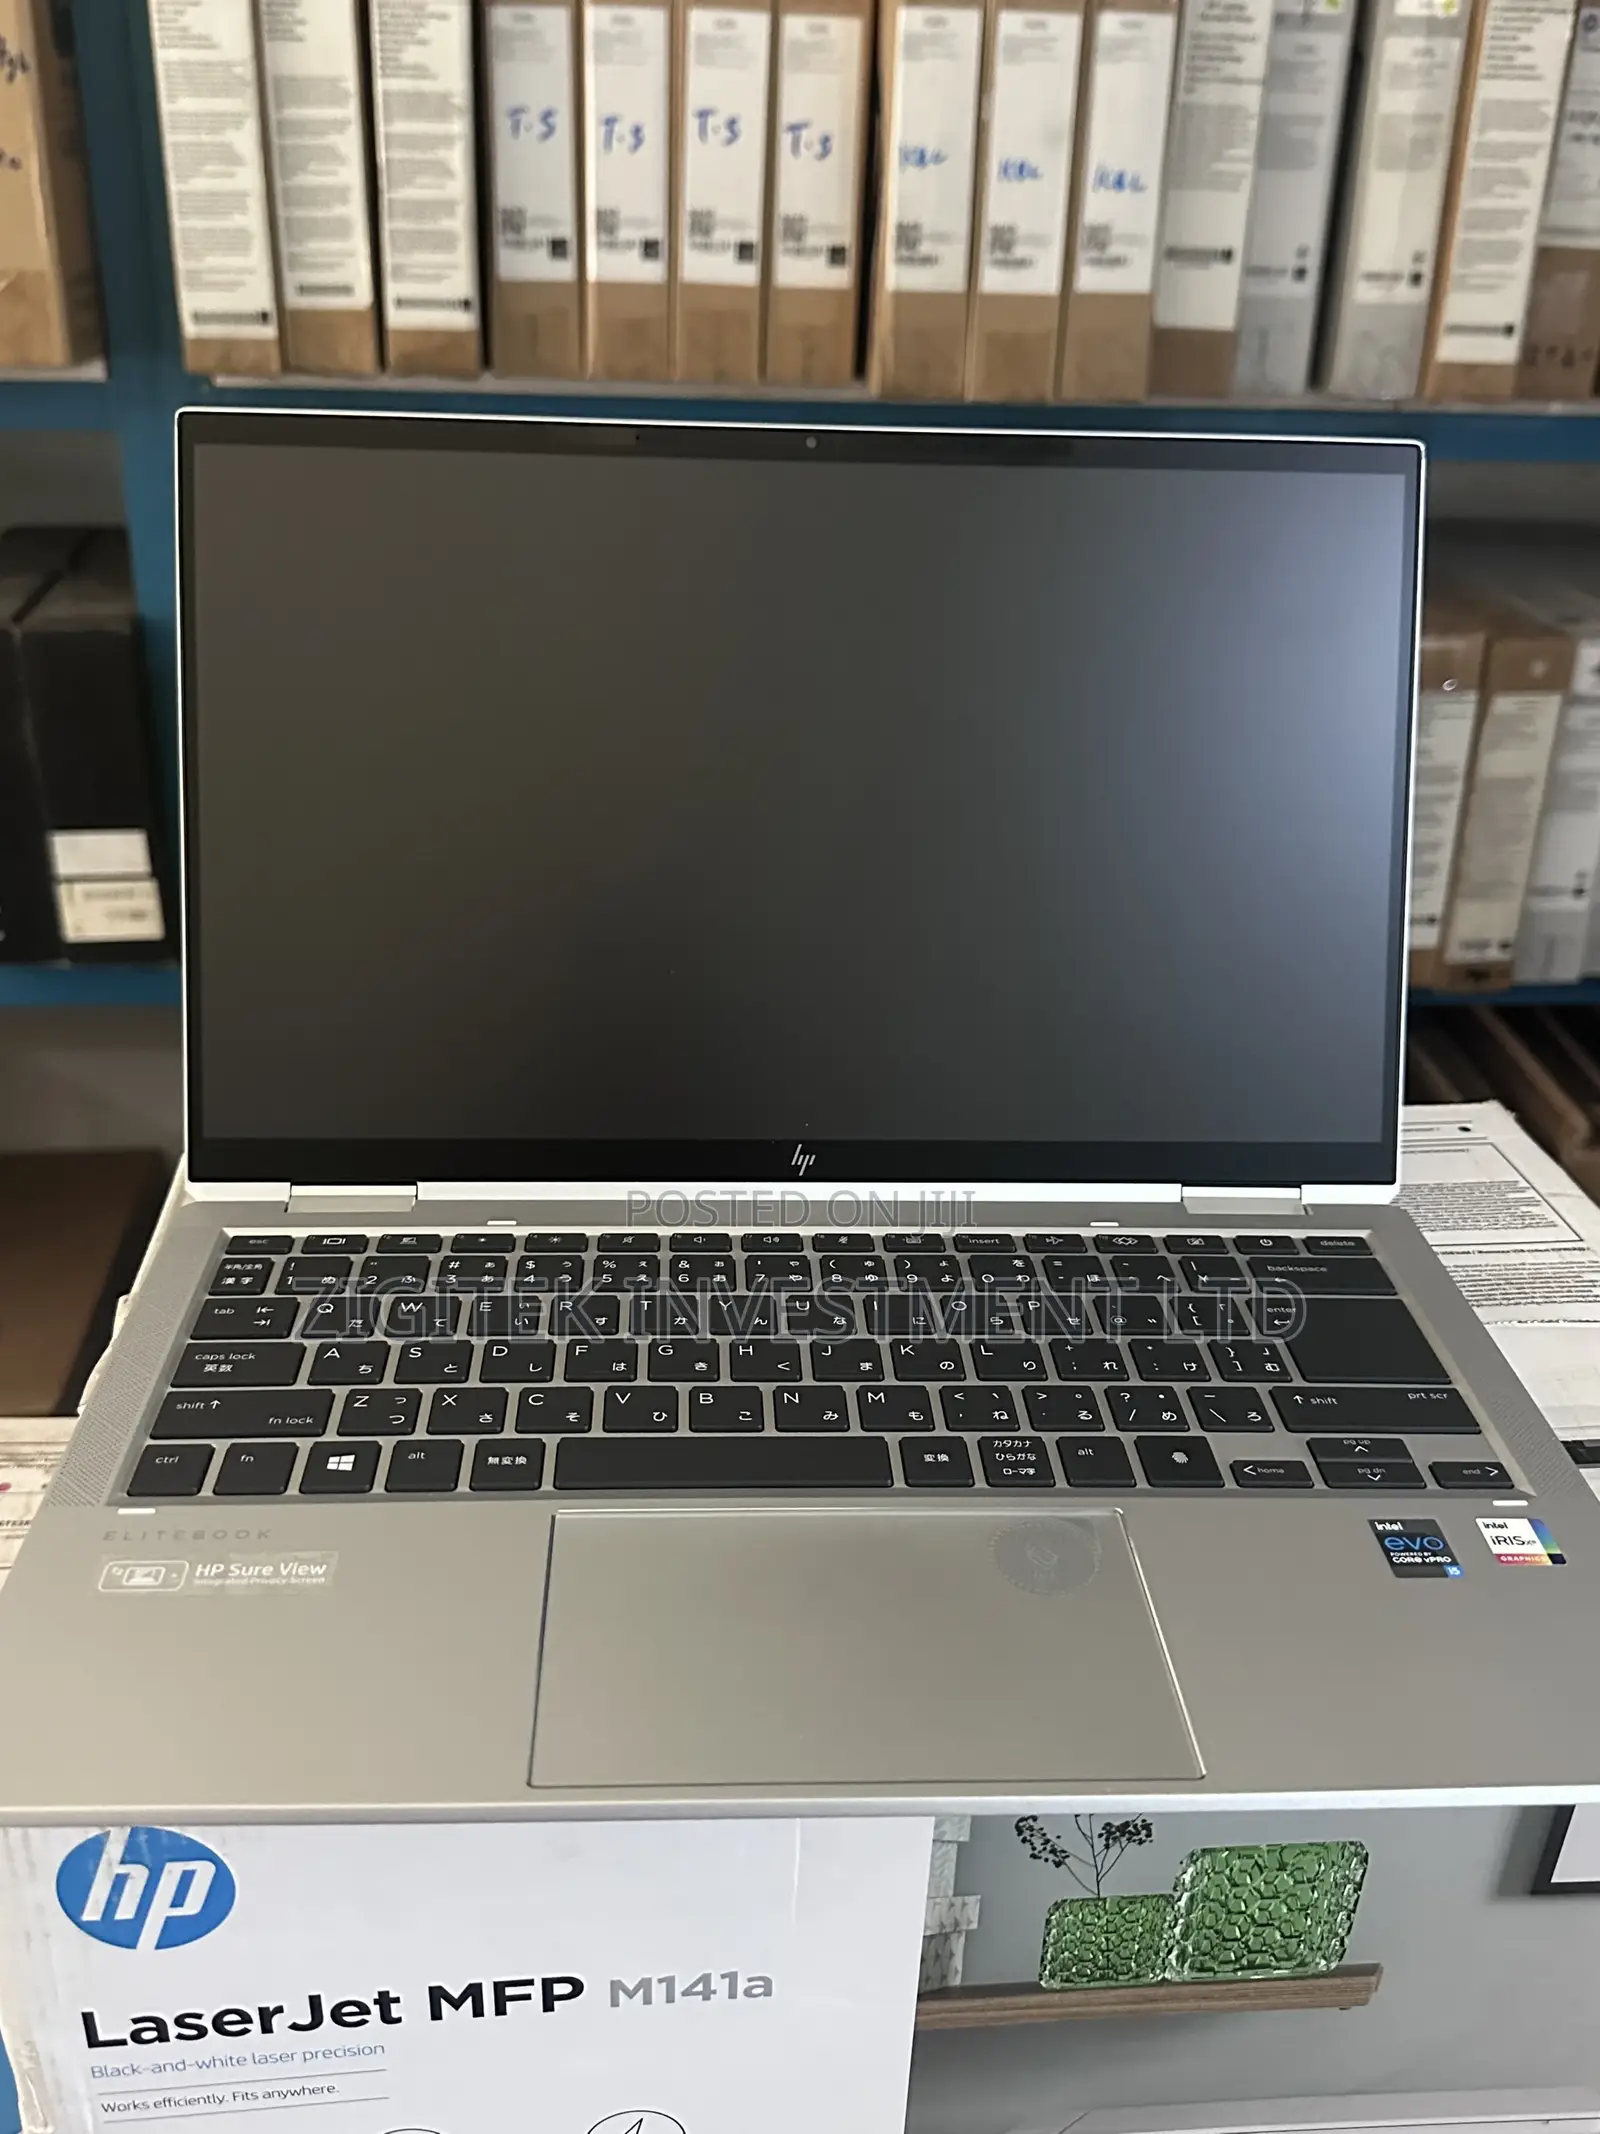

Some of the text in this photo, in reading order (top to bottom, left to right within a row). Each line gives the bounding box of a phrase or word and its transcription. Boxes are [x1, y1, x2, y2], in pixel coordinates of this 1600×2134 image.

[968, 1237, 1000, 1245] insert
[1266, 1264, 1328, 1273] backspace
[365, 1276, 377, 1285] 2
[446, 1274, 457, 1284] 3
[524, 1274, 536, 1283] 4
[602, 1274, 613, 1283] 5
[678, 1274, 690, 1283] 6
[755, 1274, 766, 1282] 7
[831, 1274, 843, 1283] 8
[906, 1274, 918, 1283] 9
[317, 1303, 335, 1313] Q
[401, 1302, 423, 1312] W
[479, 1302, 493, 1311] E
[560, 1302, 573, 1311] R
[640, 1301, 652, 1310] T
[719, 1300, 733, 1310] Y
[796, 1301, 810, 1310] U
[1028, 1301, 1041, 1310] P
[214, 1307, 235, 1315] tab
[1266, 1306, 1296, 1314] enter
[324, 1348, 341, 1358] A
[408, 1347, 422, 1357] S
[492, 1346, 508, 1357] D
[575, 1346, 589, 1356] F
[658, 1345, 673, 1356] G
[739, 1346, 753, 1356] H
[821, 1345, 832, 1356] J
[901, 1345, 915, 1356] K
[981, 1345, 994, 1355] L
[195, 1353, 225, 1361] caps
[353, 1395, 370, 1407] Z
[442, 1395, 458, 1406] X
[528, 1394, 545, 1405] C
[615, 1392, 631, 1404] V
[699, 1393, 714, 1404] B
[784, 1392, 799, 1404] N
[868, 1392, 885, 1403] M
[1310, 1396, 1338, 1405] shift
[1407, 1392, 1448, 1401] prt scr
[175, 1401, 205, 1410] shift
[268, 1416, 314, 1425] fn lock
[407, 1452, 426, 1460] alt
[1077, 1448, 1094, 1456] alt
[155, 1455, 179, 1464] ctrl
[240, 1454, 254, 1463] fn
[1375, 1522, 1403, 1531] intel
[1483, 1522, 1508, 1530] intel
[103, 1529, 272, 1541] ELITEBOOK
[1384, 1536, 1445, 1551] evo
[195, 1562, 327, 1577] HP Sure View
[81, 1825, 217, 1950] hp
[80, 1970, 774, 2049] LaserJet MFP M141a
[90, 2043, 385, 2080] Black-and-white laser precision
[101, 2083, 340, 2114] Works efficiently. Fits anywhere.
